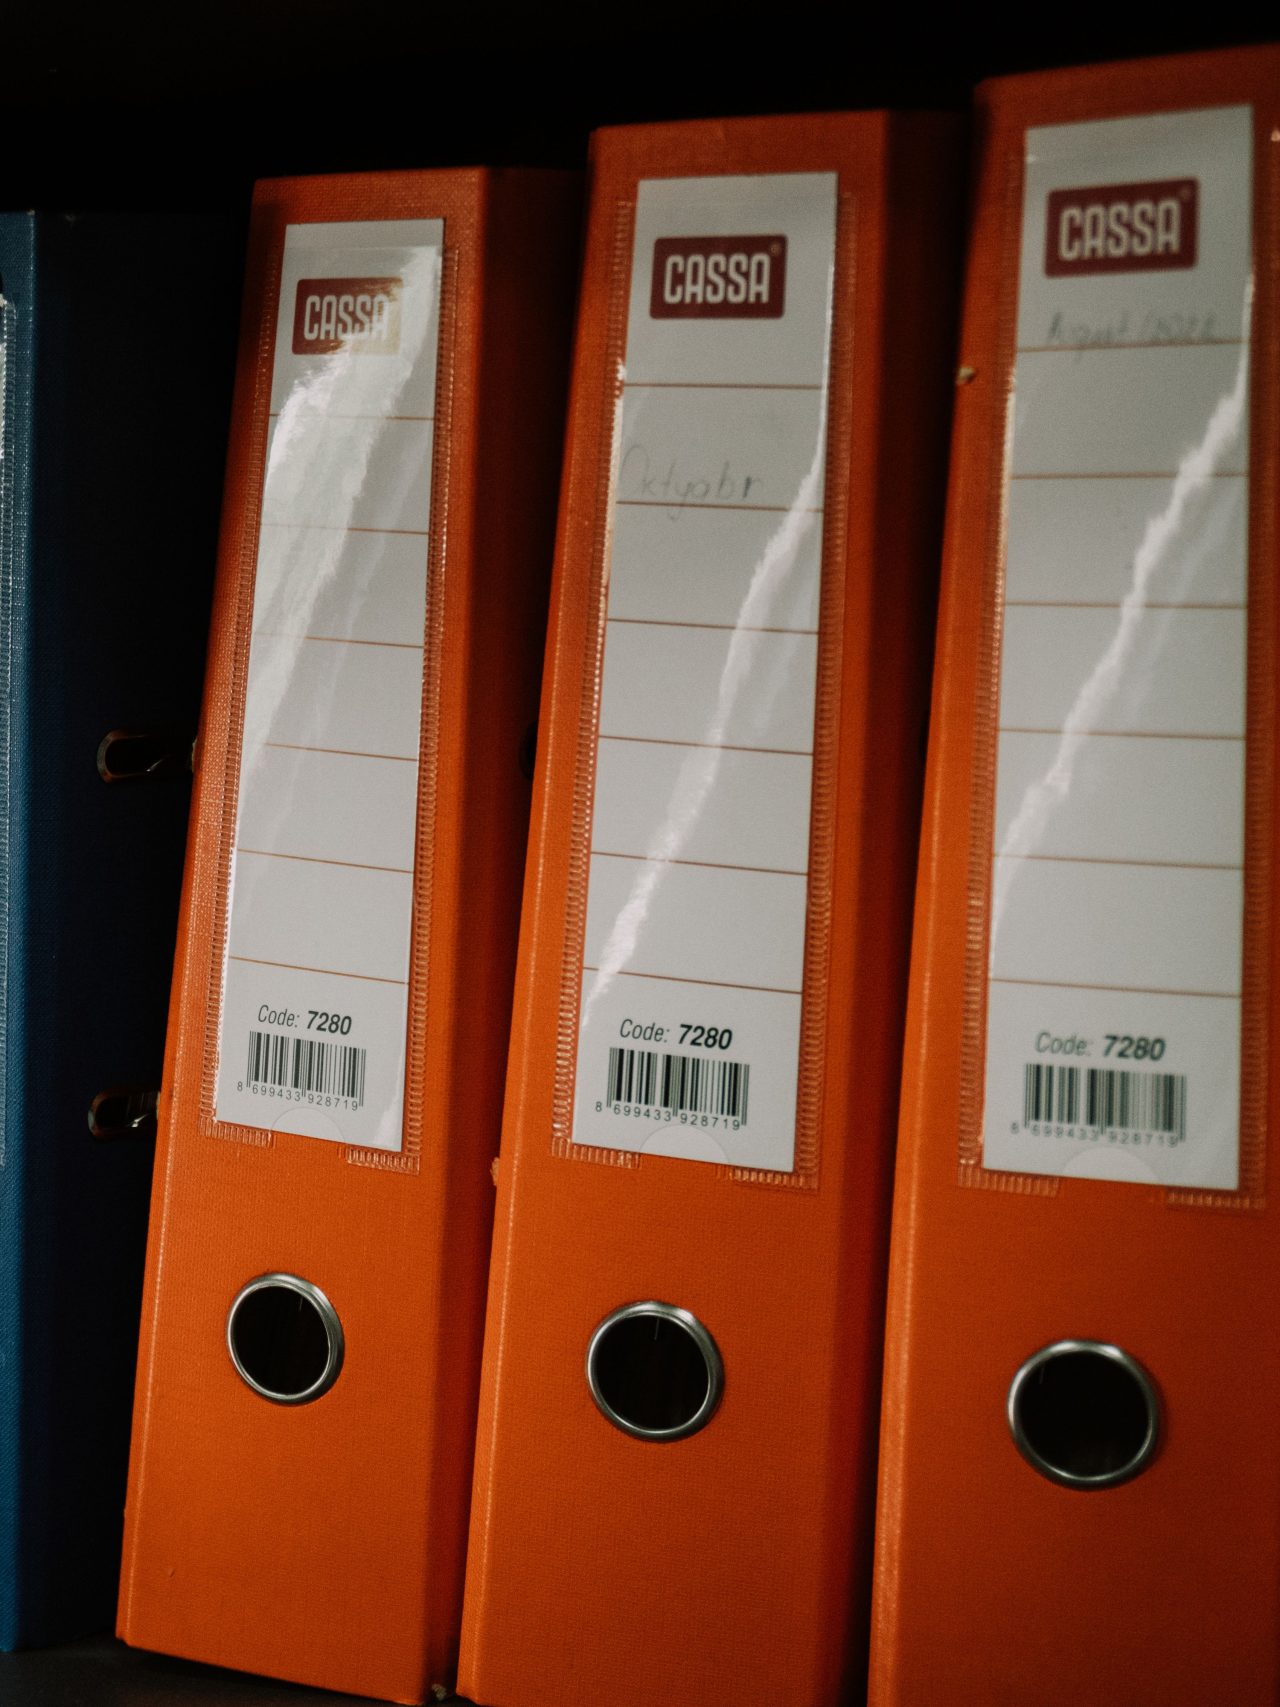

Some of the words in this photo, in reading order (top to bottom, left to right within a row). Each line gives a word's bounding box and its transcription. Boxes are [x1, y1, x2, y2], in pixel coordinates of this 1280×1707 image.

[1059, 199, 1181, 262] CASSA
[663, 252, 770, 304] CASSA
[303, 293, 390, 341] CASSA
[257, 1004, 301, 1029] Code:
[306, 1010, 353, 1036] 7280
[619, 1018, 670, 1043] Code:
[678, 1023, 733, 1050] 7280
[1034, 1030, 1094, 1057] Code:
[1102, 1033, 1167, 1062] 7280
